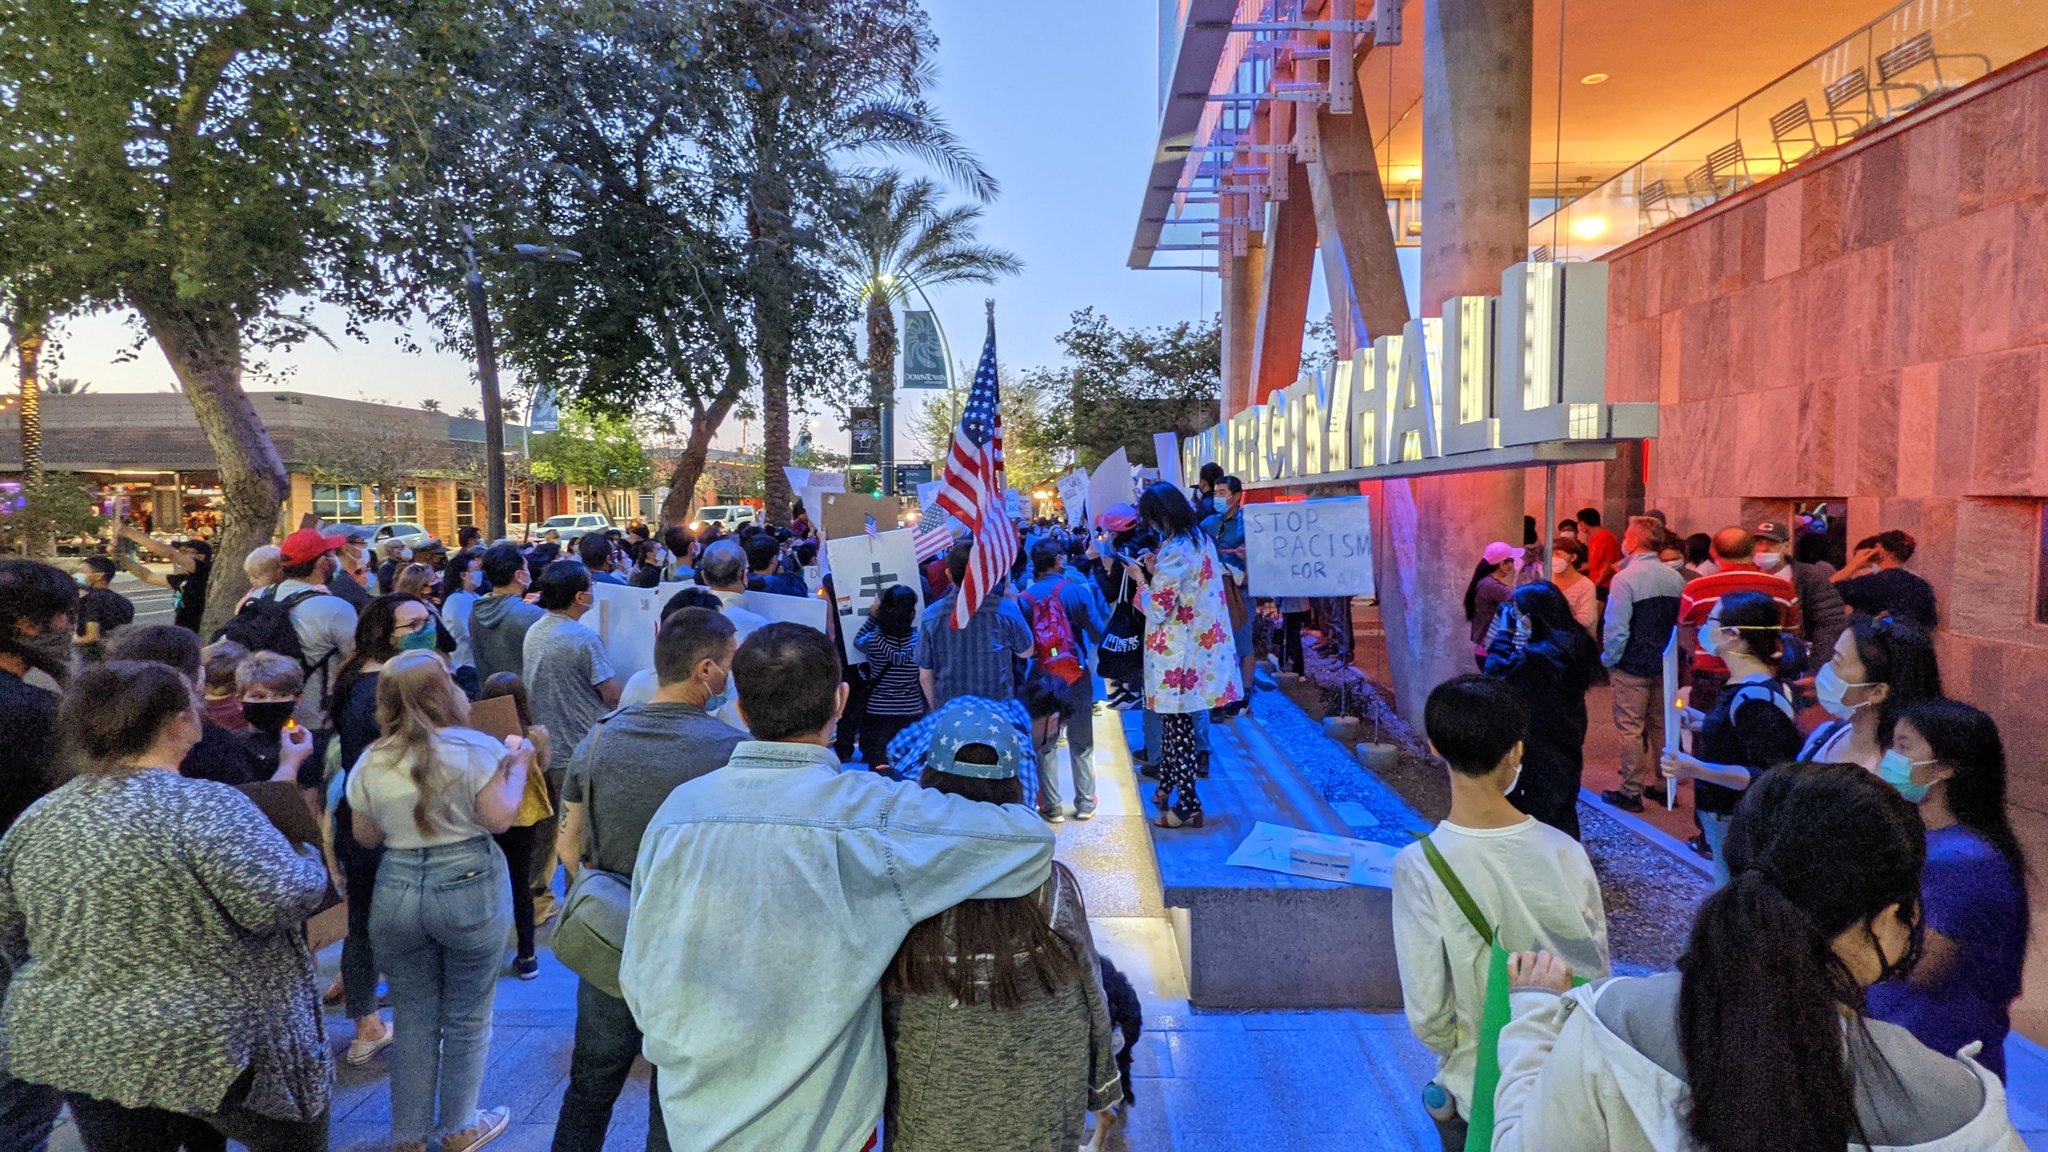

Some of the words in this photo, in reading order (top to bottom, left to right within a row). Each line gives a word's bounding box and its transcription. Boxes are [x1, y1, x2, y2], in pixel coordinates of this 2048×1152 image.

[904, 373, 946, 381] DOWNTOWN
[1266, 361, 1349, 480] CITY
[1352, 262, 1612, 468] HALL
[1253, 508, 1319, 534] STOP
[1273, 534, 1371, 559] RACISM
[1291, 561, 1327, 579] FOR
